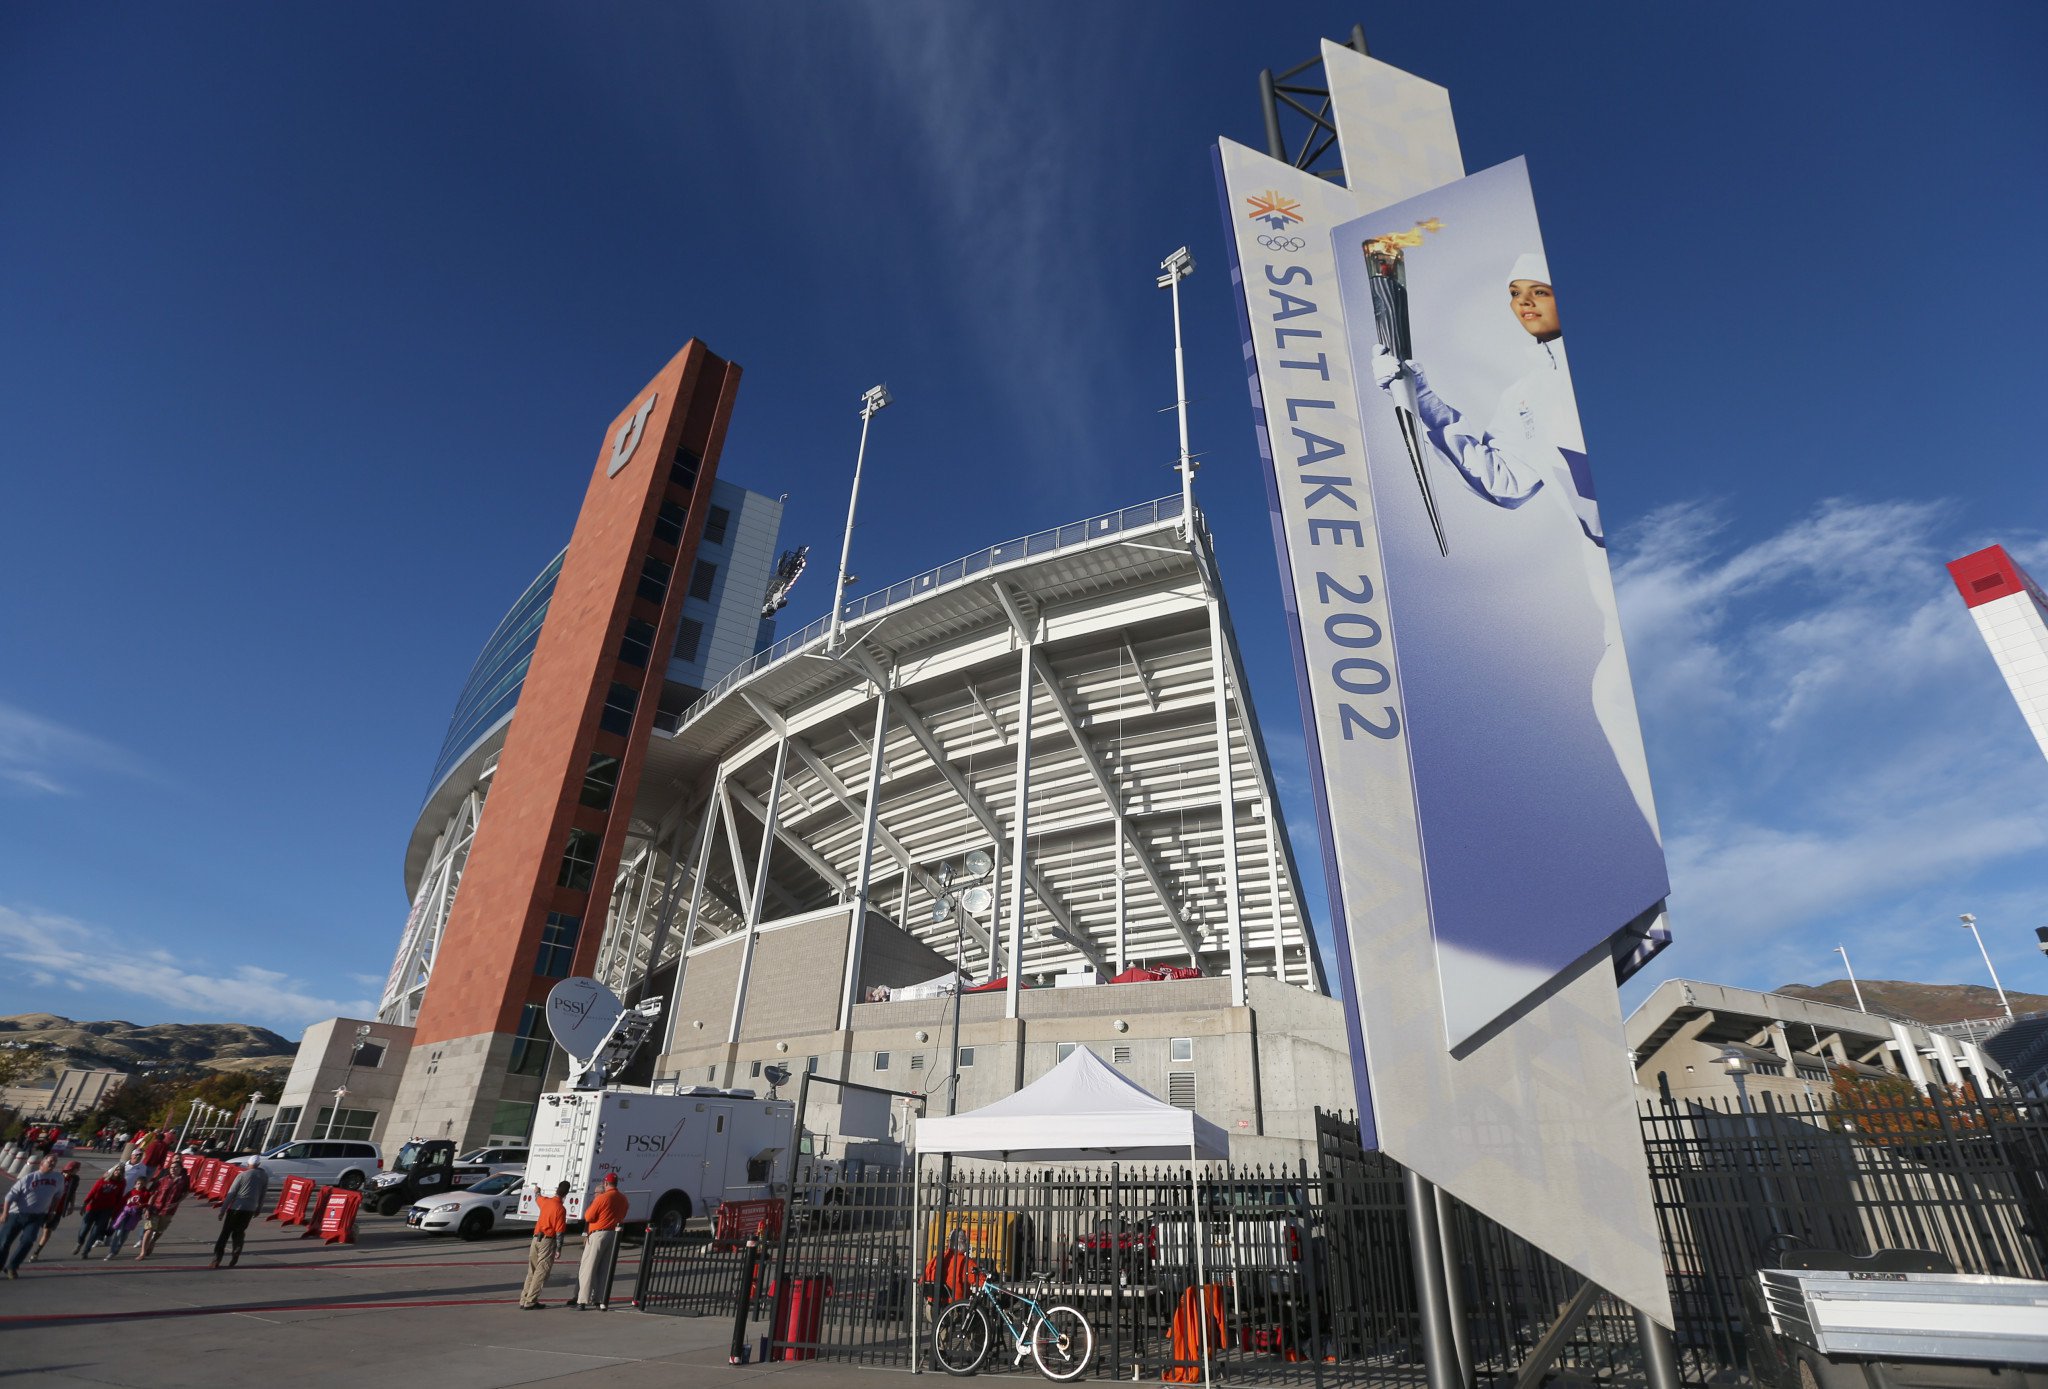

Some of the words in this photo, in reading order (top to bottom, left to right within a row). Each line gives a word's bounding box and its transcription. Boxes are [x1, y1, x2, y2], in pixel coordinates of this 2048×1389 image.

[1265, 264, 1330, 381] SALT
[606, 392, 658, 479] U
[1286, 398, 1365, 547] LAKE
[1316, 572, 1400, 740] 2002
[554, 997, 585, 1015] PSSI
[598, 1162, 610, 1170] HD
[626, 1134, 667, 1152] PSSI
